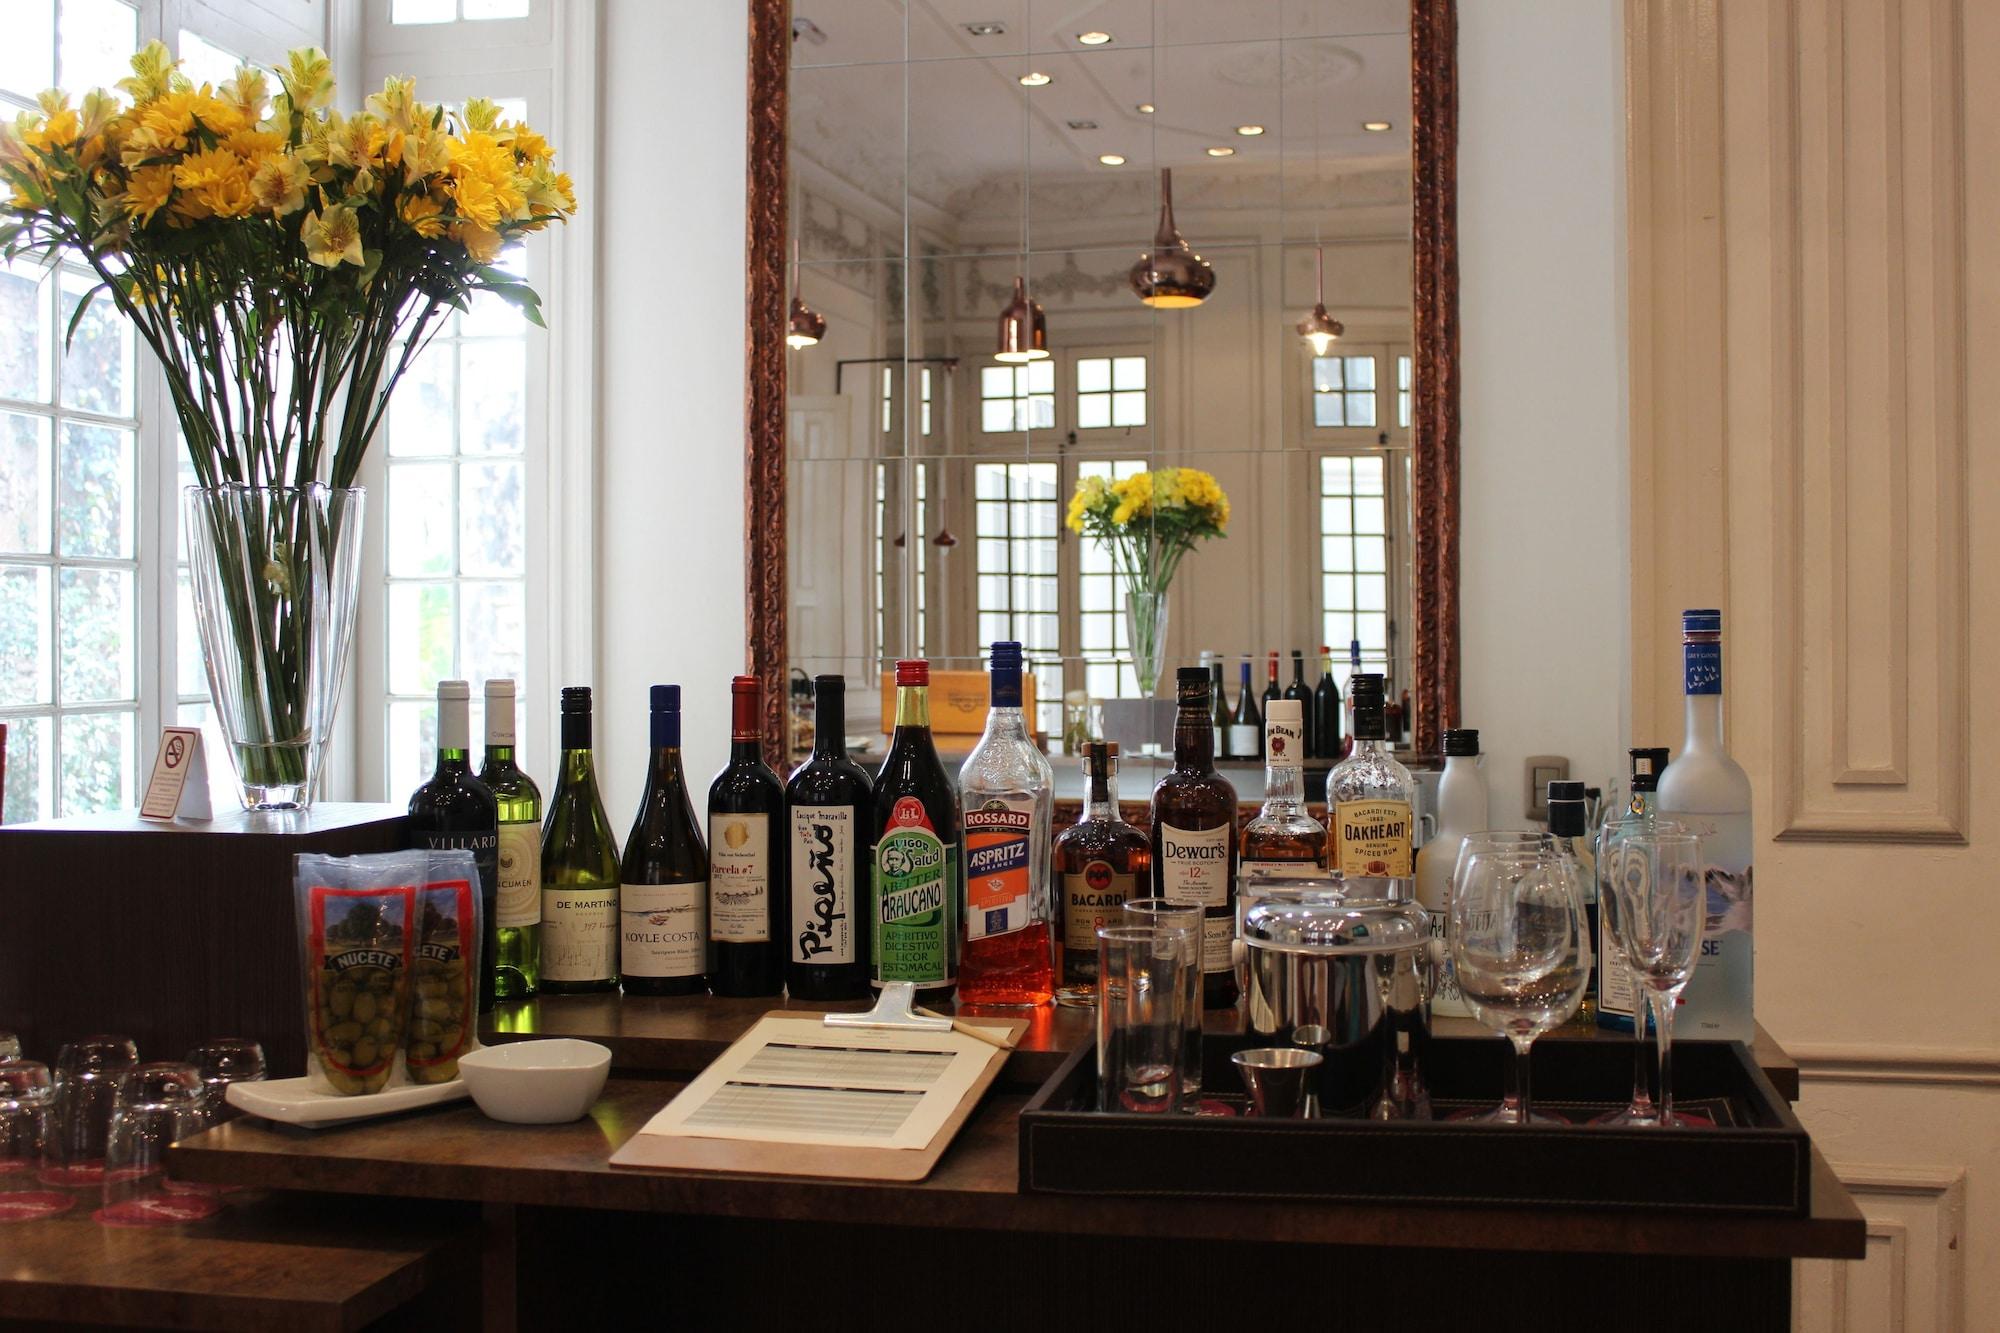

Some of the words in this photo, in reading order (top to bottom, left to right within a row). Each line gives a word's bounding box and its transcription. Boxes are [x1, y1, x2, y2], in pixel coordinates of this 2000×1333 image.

[967, 812, 1027, 826] ROSSARD
[1345, 822, 1405, 840] OAKHEART
[429, 836, 496, 849] VILLARD
[895, 839, 929, 853] VIGOR
[906, 848, 939, 870] Salud
[970, 842, 1025, 867] ASPRITZ
[711, 863, 740, 875] Parcela
[980, 860, 1014, 871] ORANGE
[1190, 867, 1201, 878] 12
[556, 901, 571, 909] DE
[882, 884, 941, 923] ARAUCANO
[625, 932, 660, 943] KOYLE
[662, 931, 700, 943] COSTA
[885, 931, 938, 940] APERITIVO
[338, 952, 394, 968] NUCETE
[882, 962, 943, 972] ESTOMACAL
